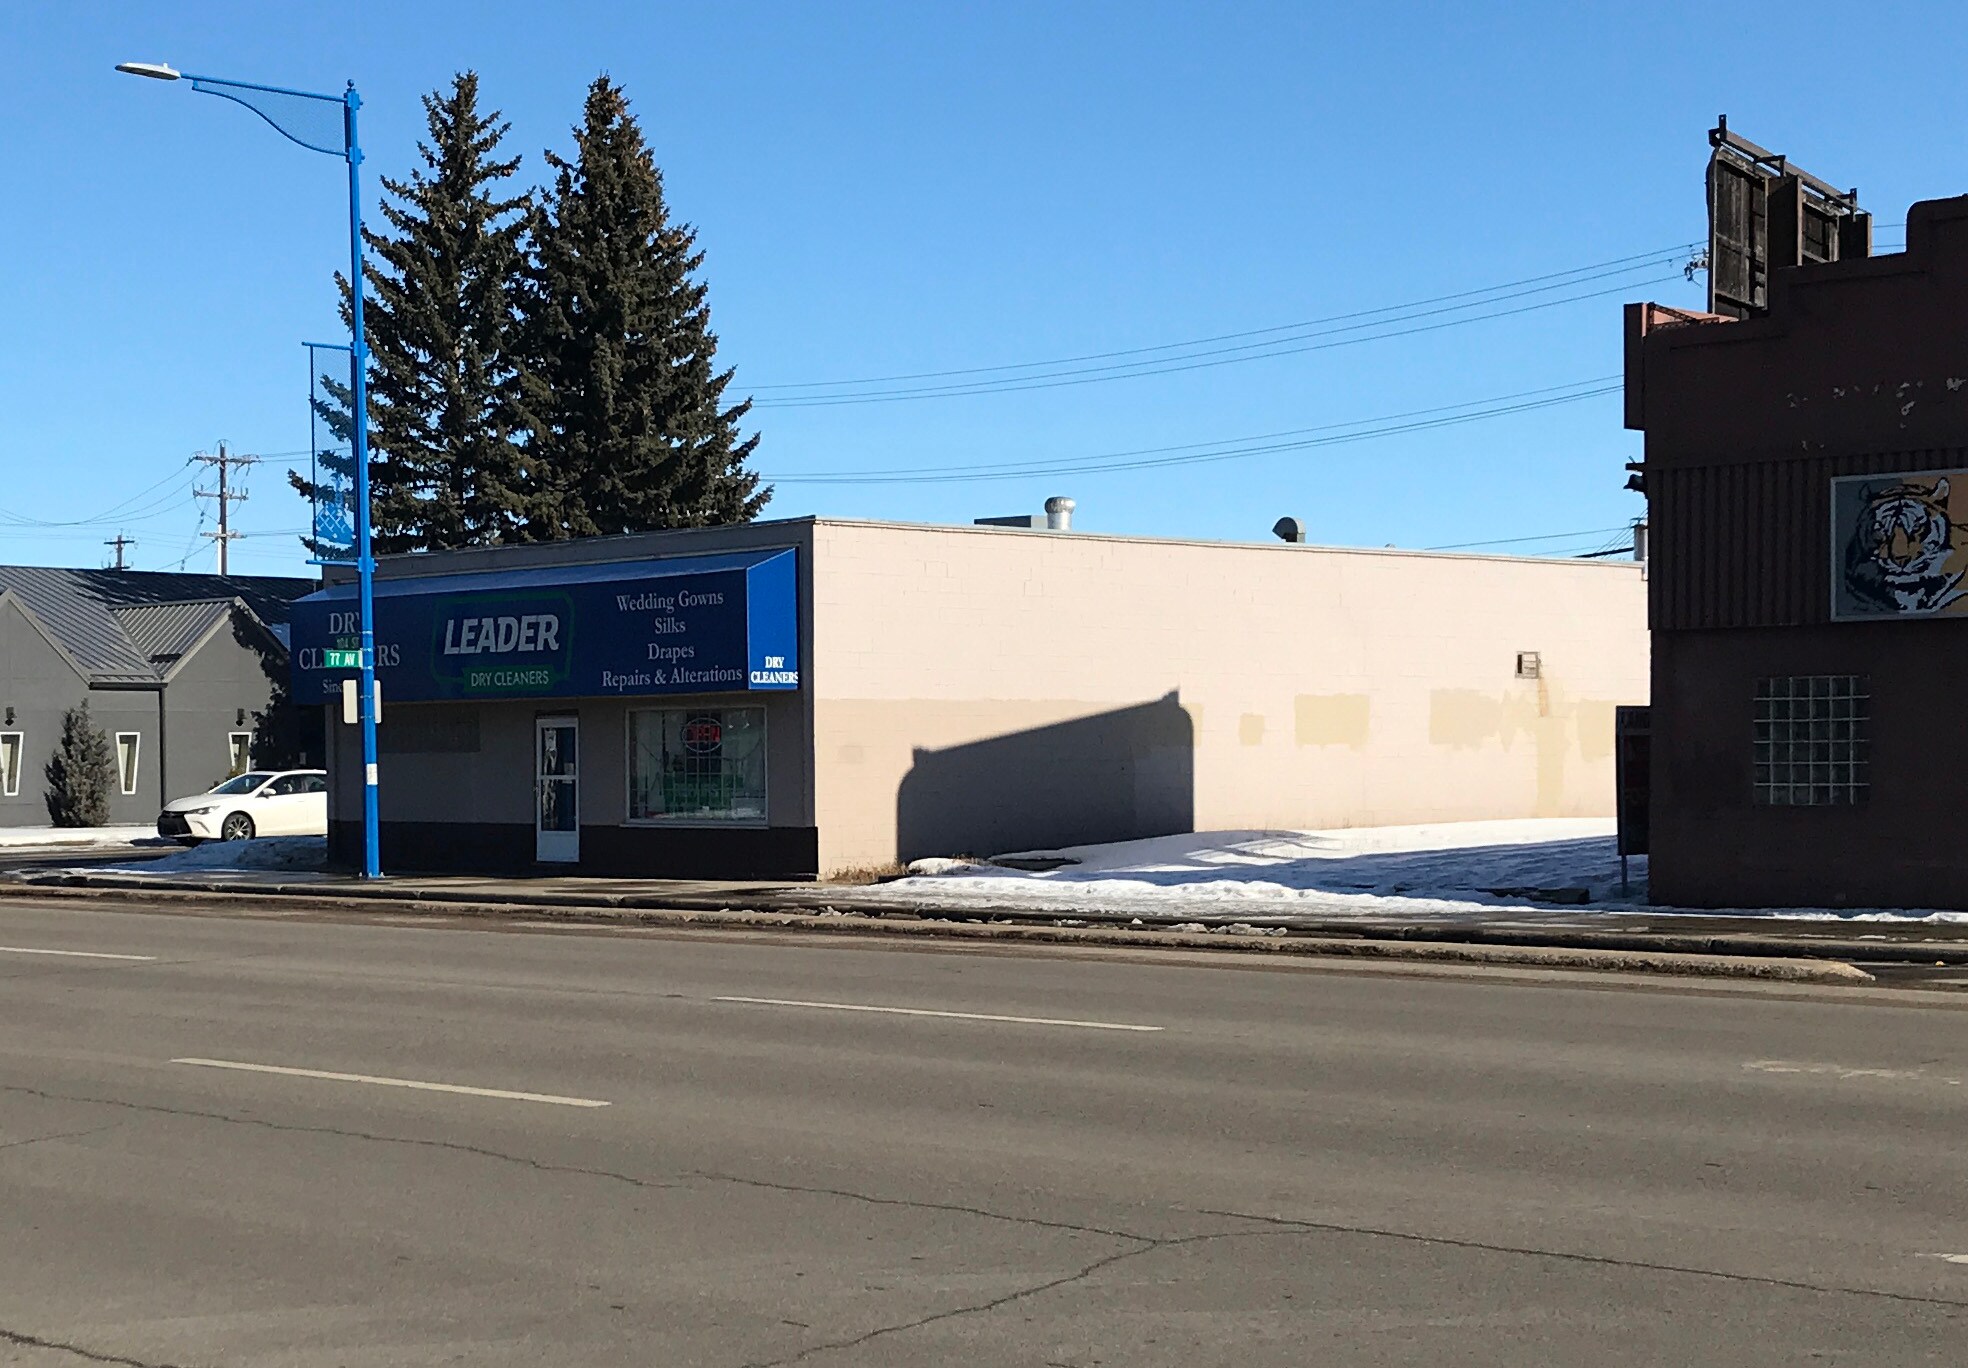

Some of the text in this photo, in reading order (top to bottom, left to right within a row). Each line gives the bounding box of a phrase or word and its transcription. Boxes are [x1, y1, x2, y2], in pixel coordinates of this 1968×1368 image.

[616, 590, 724, 613] Wedding Gowns
[655, 617, 686, 634] Silks
[443, 614, 560, 655] LEADER
[330, 652, 356, 666] 77 AV
[647, 643, 695, 663] Drapes
[765, 656, 785, 669] DRY
[471, 671, 549, 687] DRY CLEANERS
[602, 665, 743, 691] Repairs & Alterations
[751, 671, 798, 684] CLEANERS
